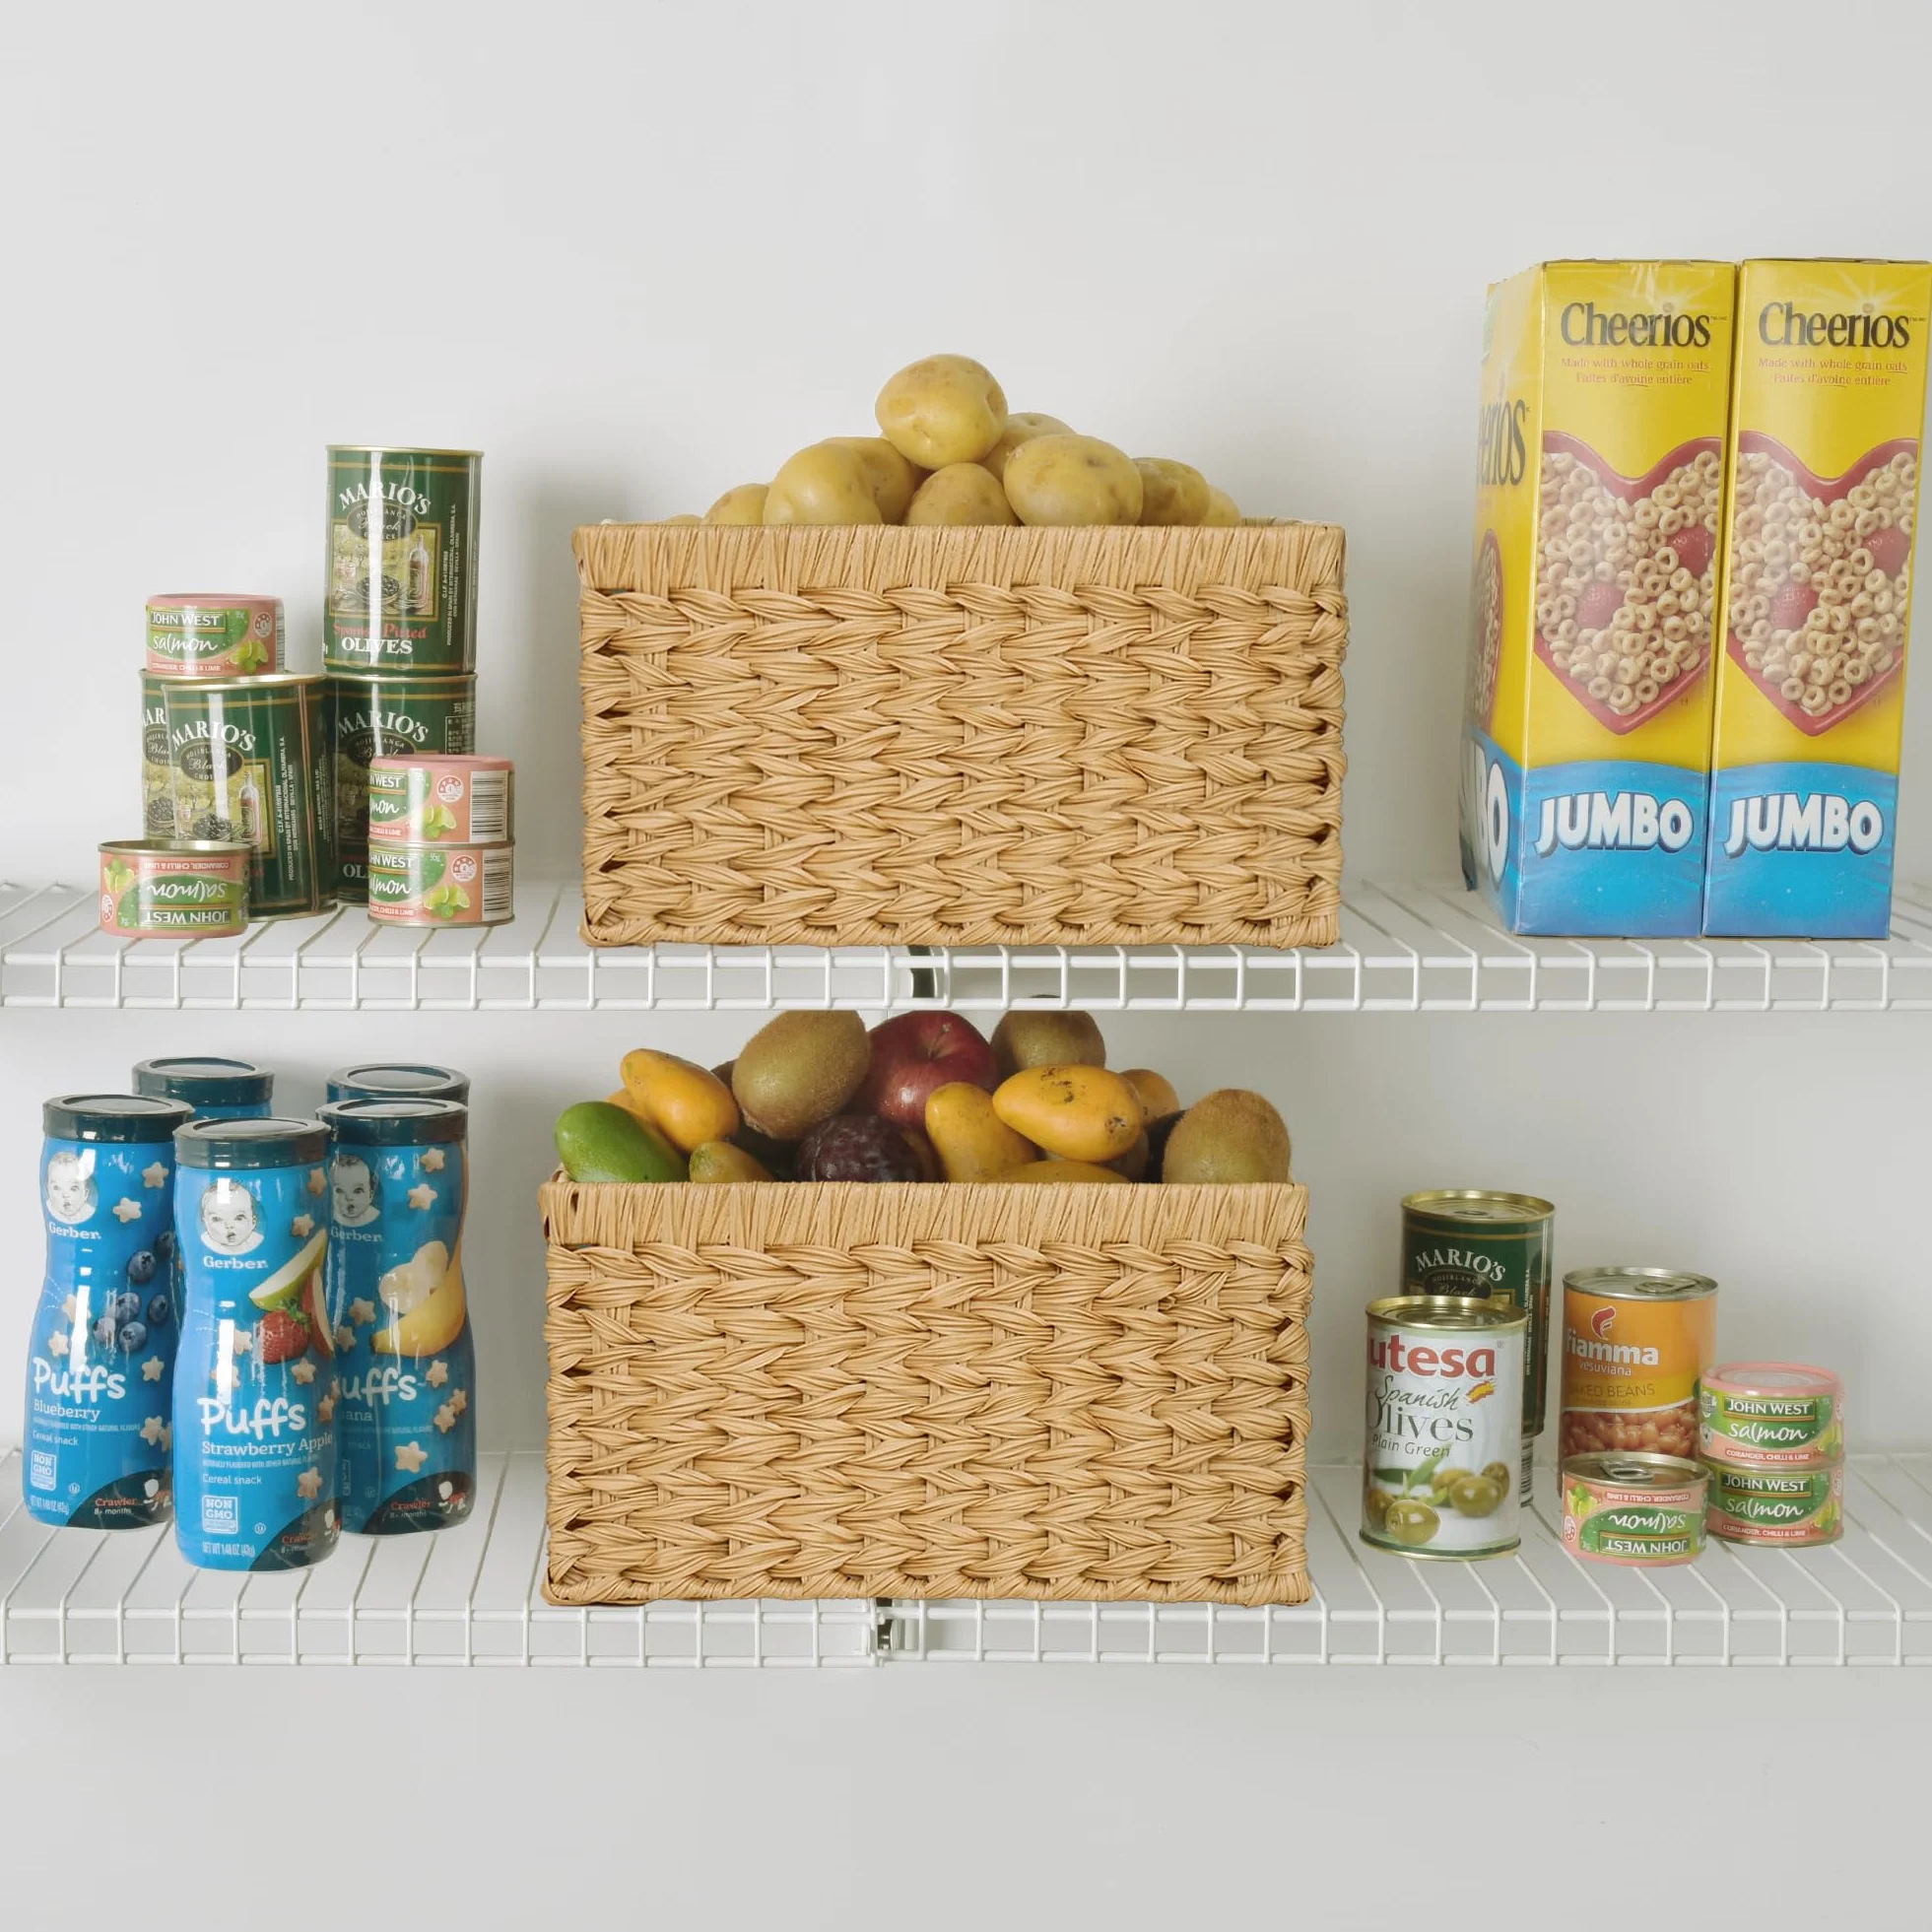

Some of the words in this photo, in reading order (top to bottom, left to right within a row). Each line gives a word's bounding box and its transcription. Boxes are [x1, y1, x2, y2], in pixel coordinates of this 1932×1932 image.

[1561, 301, 1710, 348] Cheerios
[1759, 300, 1910, 349] Cheerios
[1561, 358, 1589, 368] Made
[1593, 358, 1618, 368] with
[1621, 358, 1653, 368] whole
[1656, 360, 1684, 371] grain
[1687, 361, 1709, 370] oats
[1759, 358, 1787, 368] Made
[1790, 358, 1816, 368] with
[1819, 359, 1852, 369] whole
[1855, 361, 1882, 372] grain
[1886, 362, 1907, 371] oats
[1610, 373, 1653, 384] d'avoine
[1808, 373, 1851, 385] d'avoine
[339, 481, 432, 515] MARIO'S
[152, 612, 178, 625] JOHN
[180, 612, 220, 627] WEST
[153, 633, 218, 653] salmon
[341, 636, 413, 654] OLIVES
[338, 709, 429, 743] MARIO'S
[171, 720, 256, 752] MARIO'S
[373, 773, 401, 788] WEST
[1535, 791, 1694, 856] JUMBO
[1724, 792, 1884, 857] JUMBO
[382, 854, 412, 868] WEST
[147, 880, 228, 902] salmon
[144, 911, 186, 924] WEST
[189, 910, 228, 923] JOHN
[49, 1221, 100, 1240] Gerber
[330, 1226, 382, 1242] Gerber
[203, 1256, 267, 1270] Gerber
[1415, 1248, 1506, 1282] MARIO'S
[1566, 1327, 1659, 1366] fiamma
[1579, 1361, 1632, 1376] vesuviana
[33, 1357, 126, 1404] Puffs
[342, 1366, 417, 1407] uffs
[1375, 1374, 1460, 1411] Spanish
[1607, 1383, 1655, 1397] BEANS
[33, 1398, 100, 1423] Blueberry
[343, 1410, 372, 1422] ana
[1366, 1390, 1474, 1441] Olives
[1728, 1399, 1766, 1415] JOHN
[1769, 1402, 1810, 1416] WEST
[197, 1397, 306, 1440] Puffs
[33, 1430, 53, 1443] Cereal
[54, 1436, 79, 1446] snack
[1728, 1422, 1808, 1442] salmon
[202, 1440, 296, 1457] Strawberry
[299, 1432, 333, 1453] Apple
[1371, 1433, 1400, 1451] Plain
[1405, 1441, 1451, 1457] Green
[33, 1453, 52, 1466] NON
[33, 1463, 52, 1477] GMO
[202, 1473, 232, 1484] Cereal
[234, 1475, 262, 1485] snack
[1725, 1473, 1763, 1491] JOHN
[1765, 1479, 1807, 1492] WEST
[95, 1498, 136, 1507] Crawler
[205, 1499, 233, 1509] NON
[1725, 1498, 1804, 1518] salmon
[205, 1509, 233, 1519] GMO
[1609, 1512, 1687, 1534] salmon
[1606, 1539, 1647, 1554] WEST
[1650, 1540, 1688, 1553] JOHN
